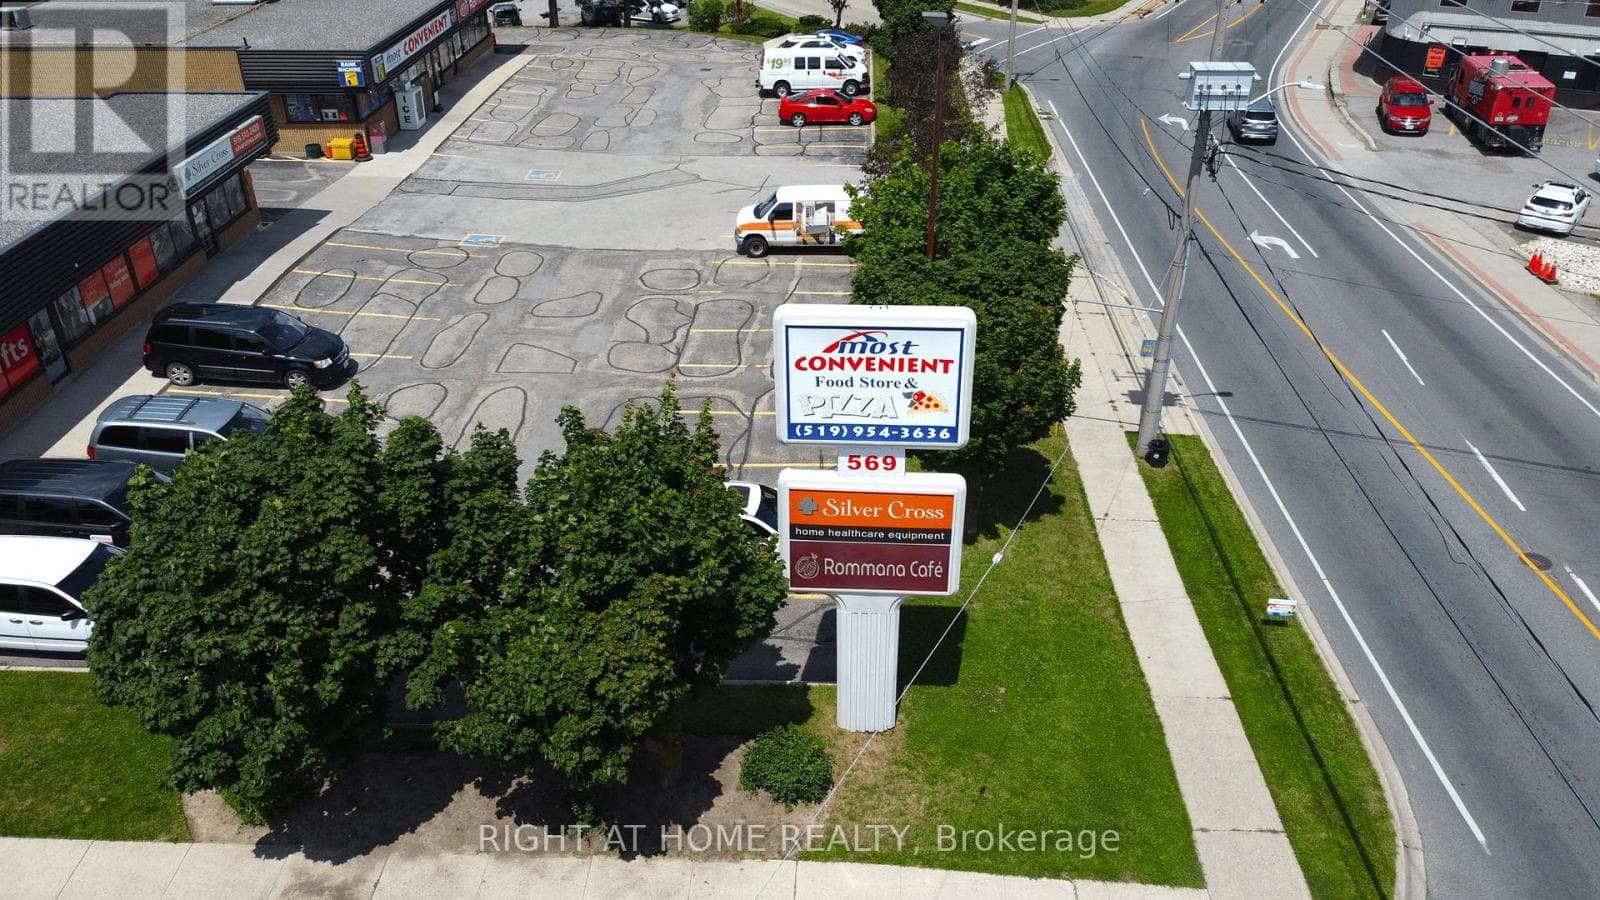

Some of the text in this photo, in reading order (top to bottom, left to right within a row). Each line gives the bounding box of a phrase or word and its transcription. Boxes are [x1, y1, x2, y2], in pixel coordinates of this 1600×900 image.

[403, 14, 449, 55] CONVENIENT
[402, 95, 412, 124] ICE
[837, 340, 920, 355] most
[794, 355, 955, 374] CONVENIENT
[815, 376, 919, 389] Food Store &
[799, 394, 899, 419] PIZZA
[847, 454, 897, 471] 569
[822, 498, 944, 519] Silver Cross
[795, 527, 945, 541] home healthcare equipment
[824, 558, 943, 578] Rommana Café
